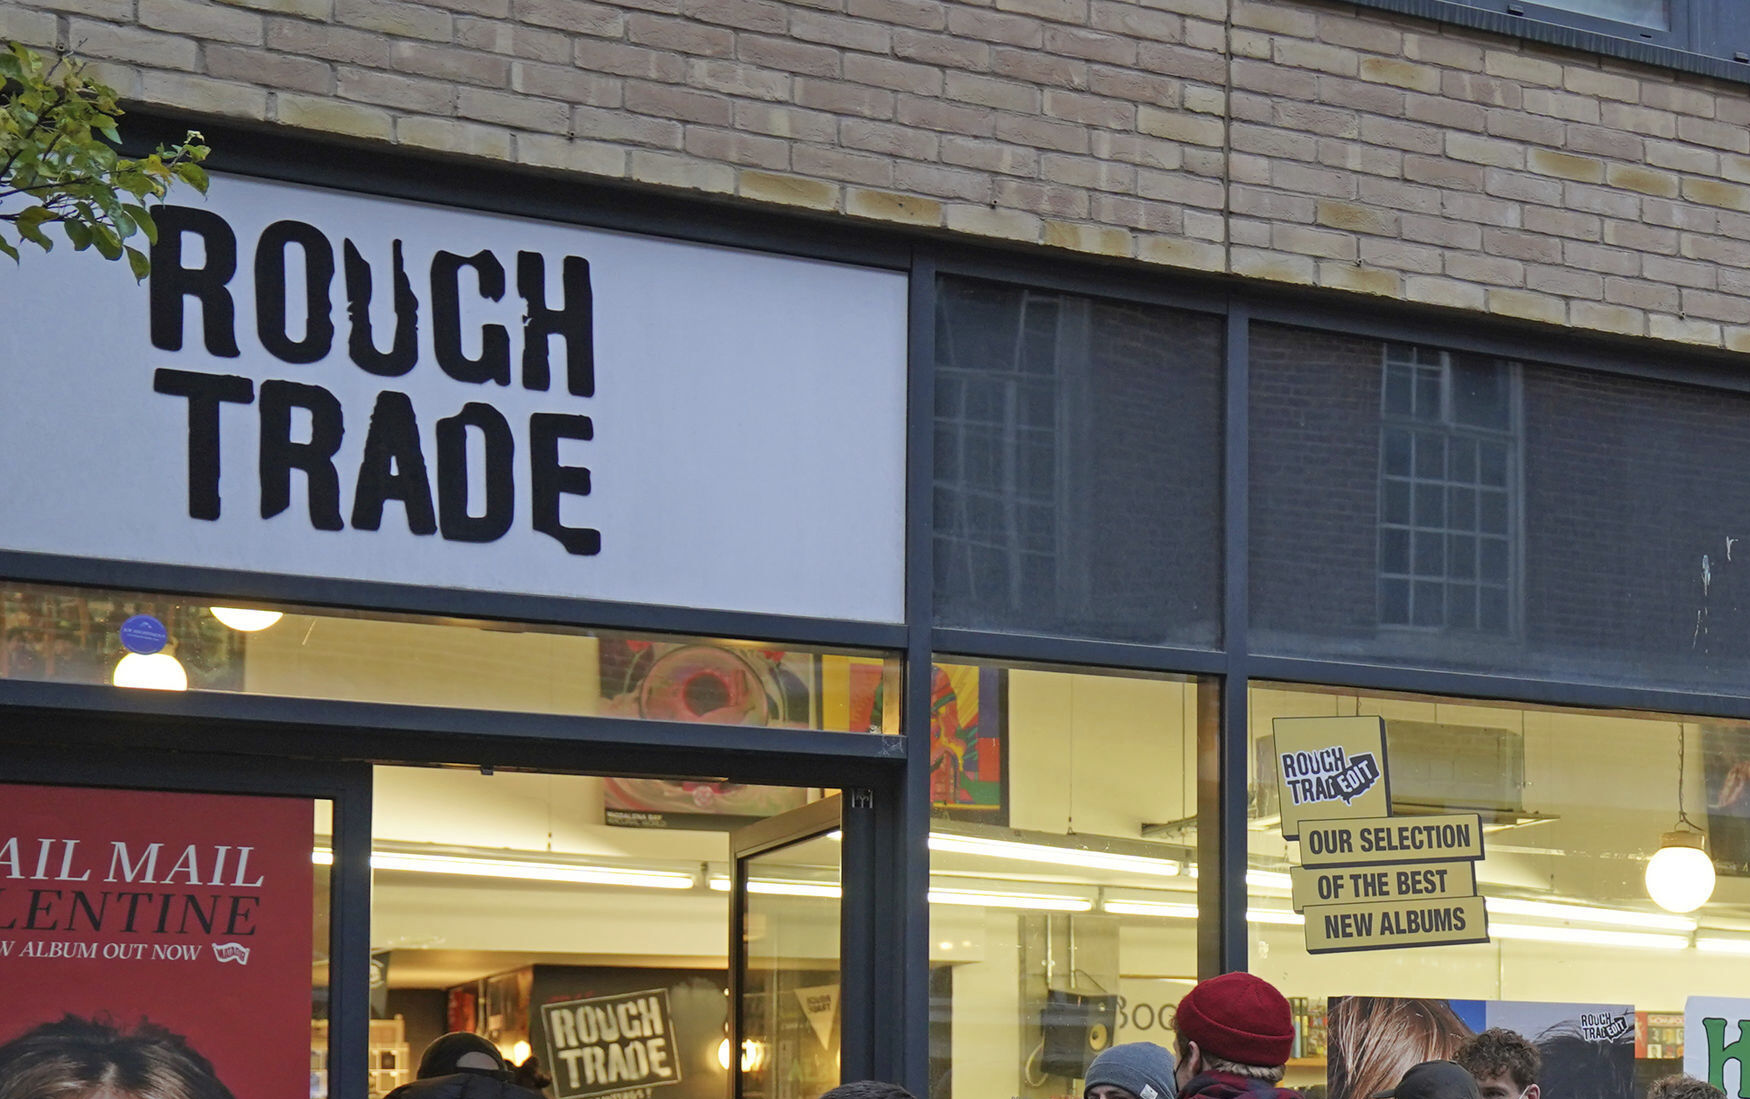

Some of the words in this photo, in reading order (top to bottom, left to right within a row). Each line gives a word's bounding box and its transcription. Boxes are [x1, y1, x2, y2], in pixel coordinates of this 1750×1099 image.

[150, 204, 596, 398] ROUGH
[153, 368, 602, 556] TRADE
[1282, 747, 1347, 778] ROUGH
[1287, 776, 1340, 805] TRAD
[1337, 760, 1374, 793] EDIT
[1308, 829, 1353, 855] OUR
[1359, 824, 1471, 853] SELECTION
[103, 841, 265, 888] MAIL
[1317, 875, 1344, 900] OF
[1350, 872, 1390, 898] THE
[1396, 869, 1448, 895] BEST
[1324, 913, 1374, 939] NEW
[1380, 907, 1466, 936] ALBUMS
[19, 941, 99, 959] ALBUM
[103, 943, 148, 961] OUT
[151, 944, 203, 961] NOW
[550, 996, 664, 1049] ROUGH
[1581, 1012, 1612, 1027] ROUGH
[1583, 1026, 1608, 1040] TRAD
[1607, 1020, 1627, 1037] EDIT
[558, 1037, 673, 1089] TRADE
